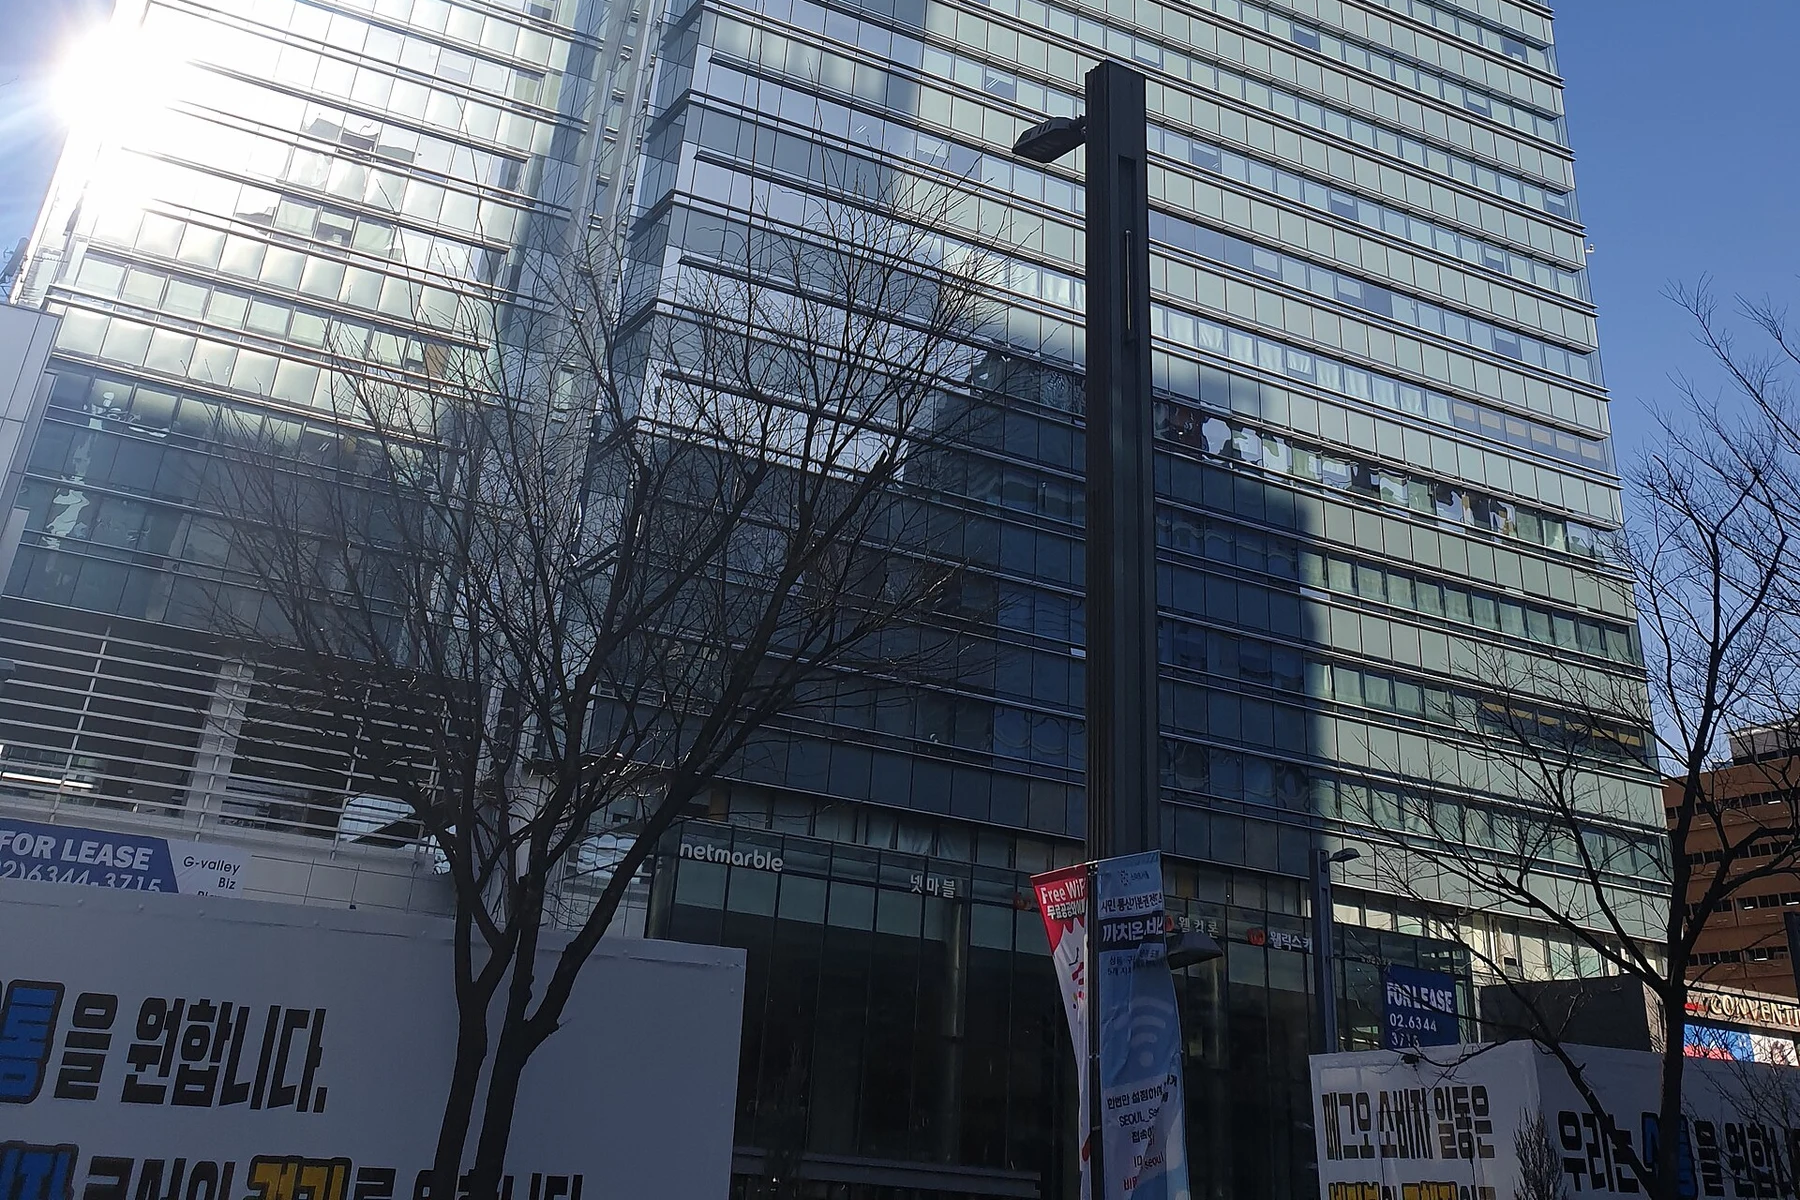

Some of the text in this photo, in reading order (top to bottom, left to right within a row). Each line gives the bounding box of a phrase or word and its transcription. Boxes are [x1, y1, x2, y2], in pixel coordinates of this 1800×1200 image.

[0, 830, 153, 871] FOR LEASE
[183, 856, 241, 874] G-valley
[679, 842, 784, 873] netmarble
[0, 859, 162, 892] 2)6344-3715
[218, 876, 236, 890] Biz
[909, 874, 956, 899] 넷마블
[1040, 877, 1087, 905] Free WiF
[1101, 898, 1117, 913] 시민
[1386, 981, 1454, 1014] FOR LEASE
[1389, 1013, 1437, 1032] 02.6344
[120, 997, 328, 1113] 원합니다.
[1433, 1085, 1496, 1160] 일동은
[1558, 1110, 1640, 1193] 우리는
